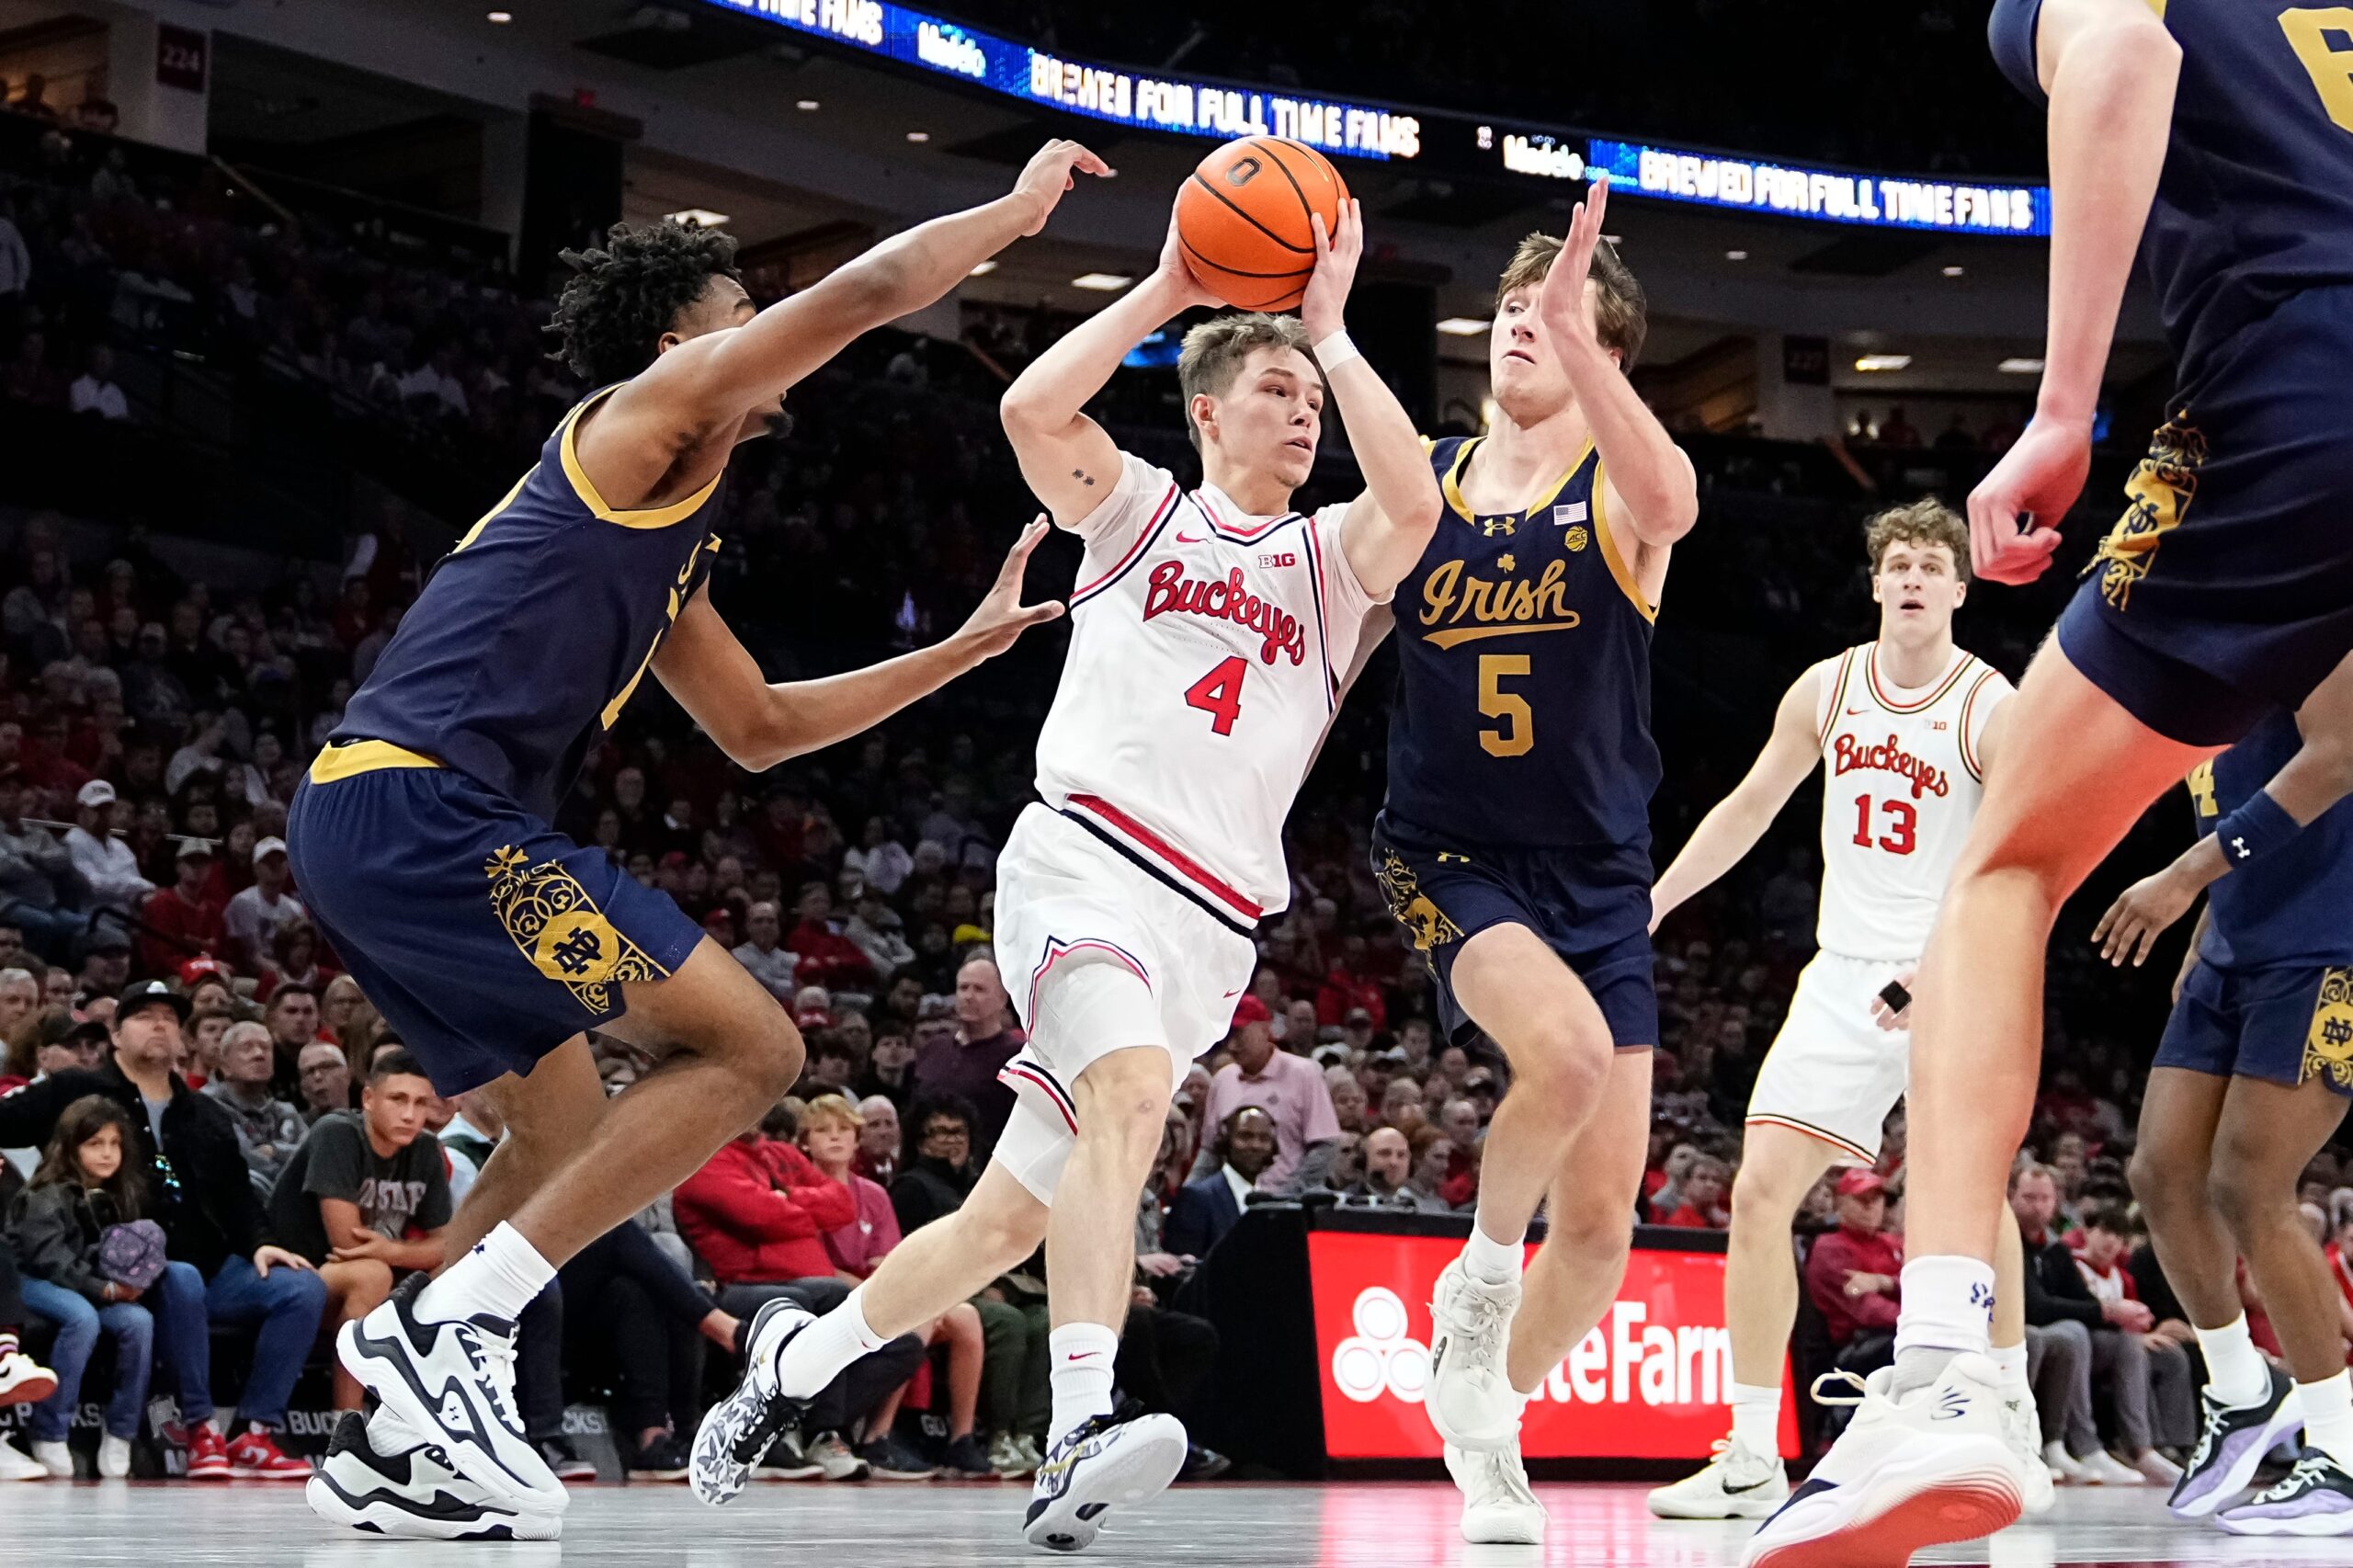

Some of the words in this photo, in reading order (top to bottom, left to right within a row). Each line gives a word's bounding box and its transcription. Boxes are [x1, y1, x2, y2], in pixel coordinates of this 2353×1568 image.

[1136, 79, 1193, 127] FOR
[1199, 87, 1267, 135] FULL
[1272, 97, 1342, 147] TIME
[1346, 108, 1420, 157] FANS
[1639, 150, 1753, 203] BREWED
[1755, 165, 1809, 211] FOR
[1809, 173, 1879, 219] FULL
[1880, 180, 1953, 224] TIME
[1953, 187, 2032, 230] FANS
[1143, 561, 1305, 666] Buckeyes
[1419, 559, 1581, 634] Irish
[1184, 655, 1248, 736] 4
[1479, 655, 1534, 757] 5
[1835, 733, 1949, 799] Buckeyes
[1853, 793, 1916, 856] 13
